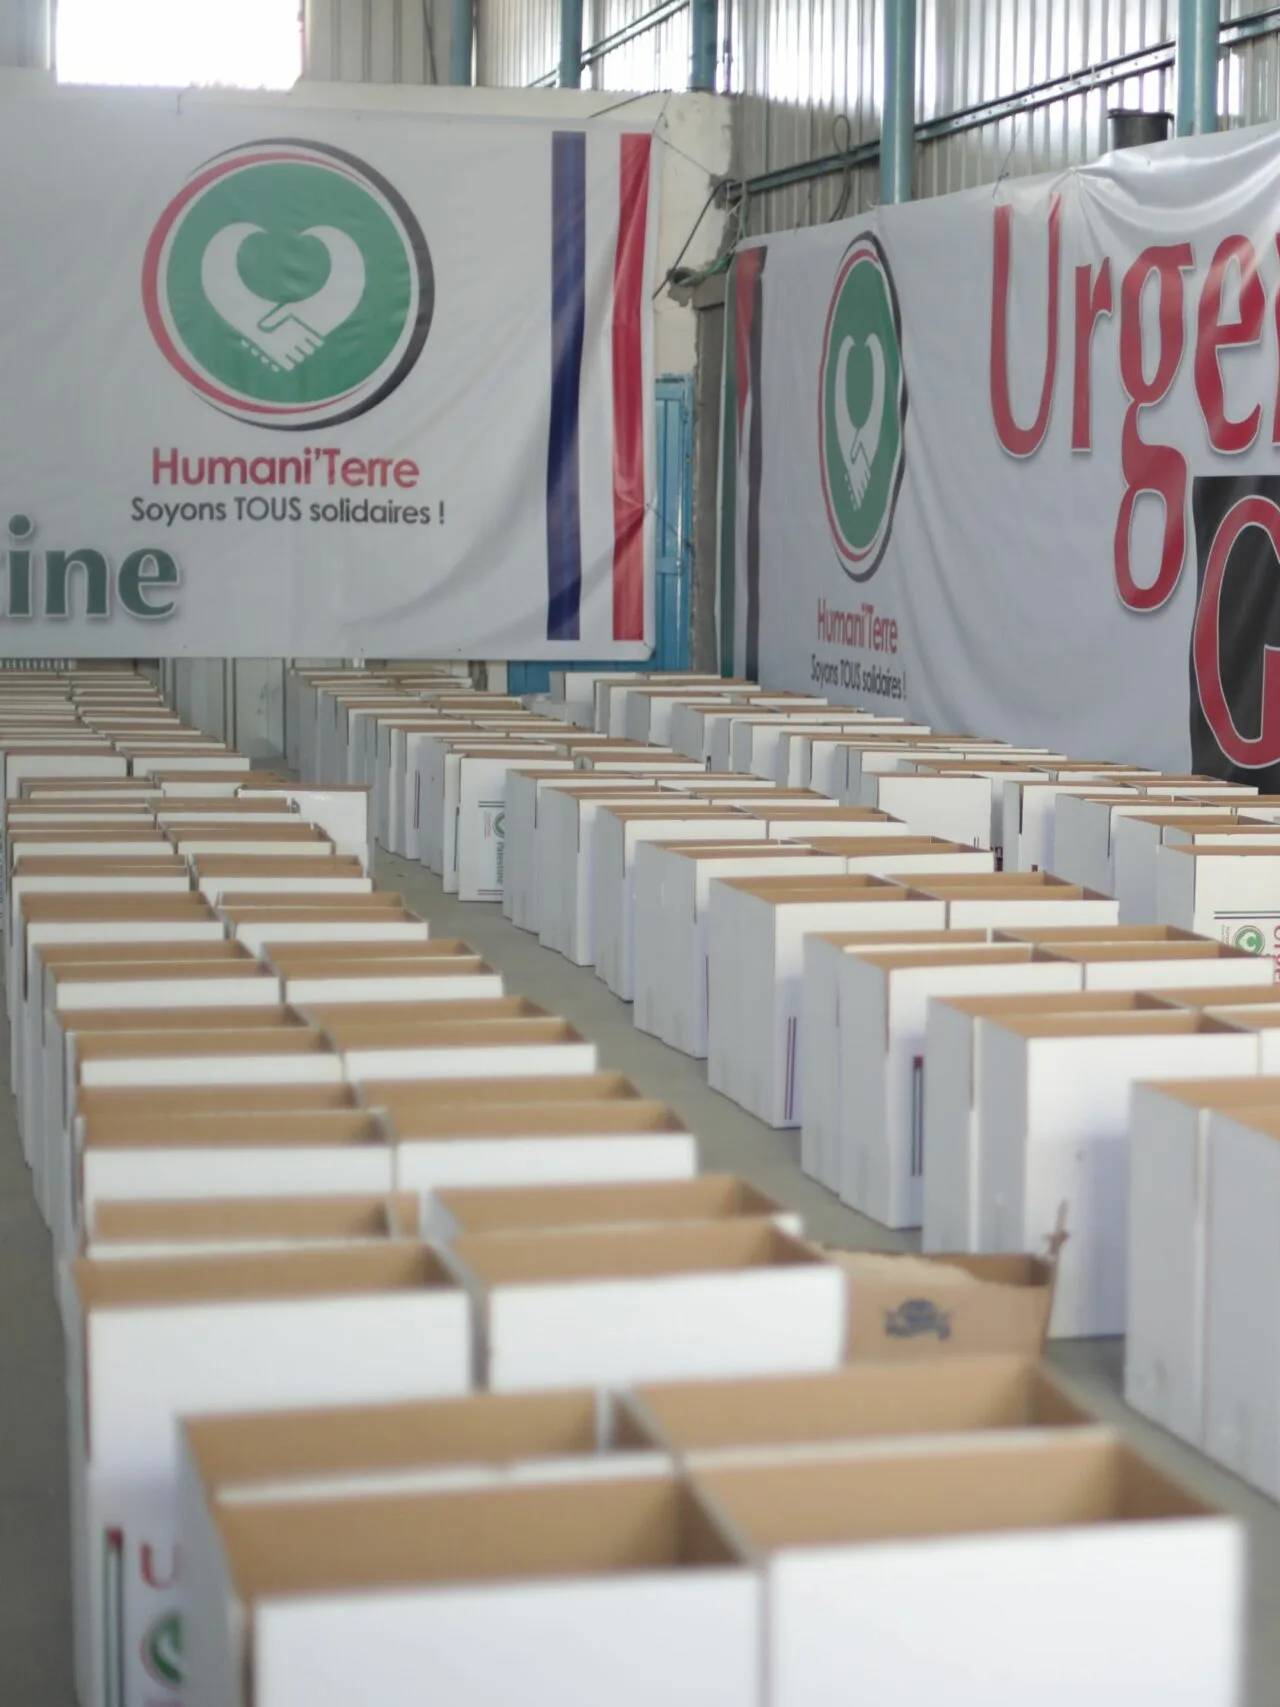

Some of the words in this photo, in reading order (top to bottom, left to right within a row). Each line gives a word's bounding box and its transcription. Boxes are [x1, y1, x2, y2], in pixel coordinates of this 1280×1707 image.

[152, 447, 420, 488] Humani'Terre
[131, 497, 227, 527] Soyons
[233, 497, 303, 521] TOUS
[309, 499, 431, 524] solidaires
[8, 513, 179, 617] ine
[811, 653, 839, 689] Soyons
[840, 659, 861, 691] TOUS
[863, 664, 902, 699] solidaires
